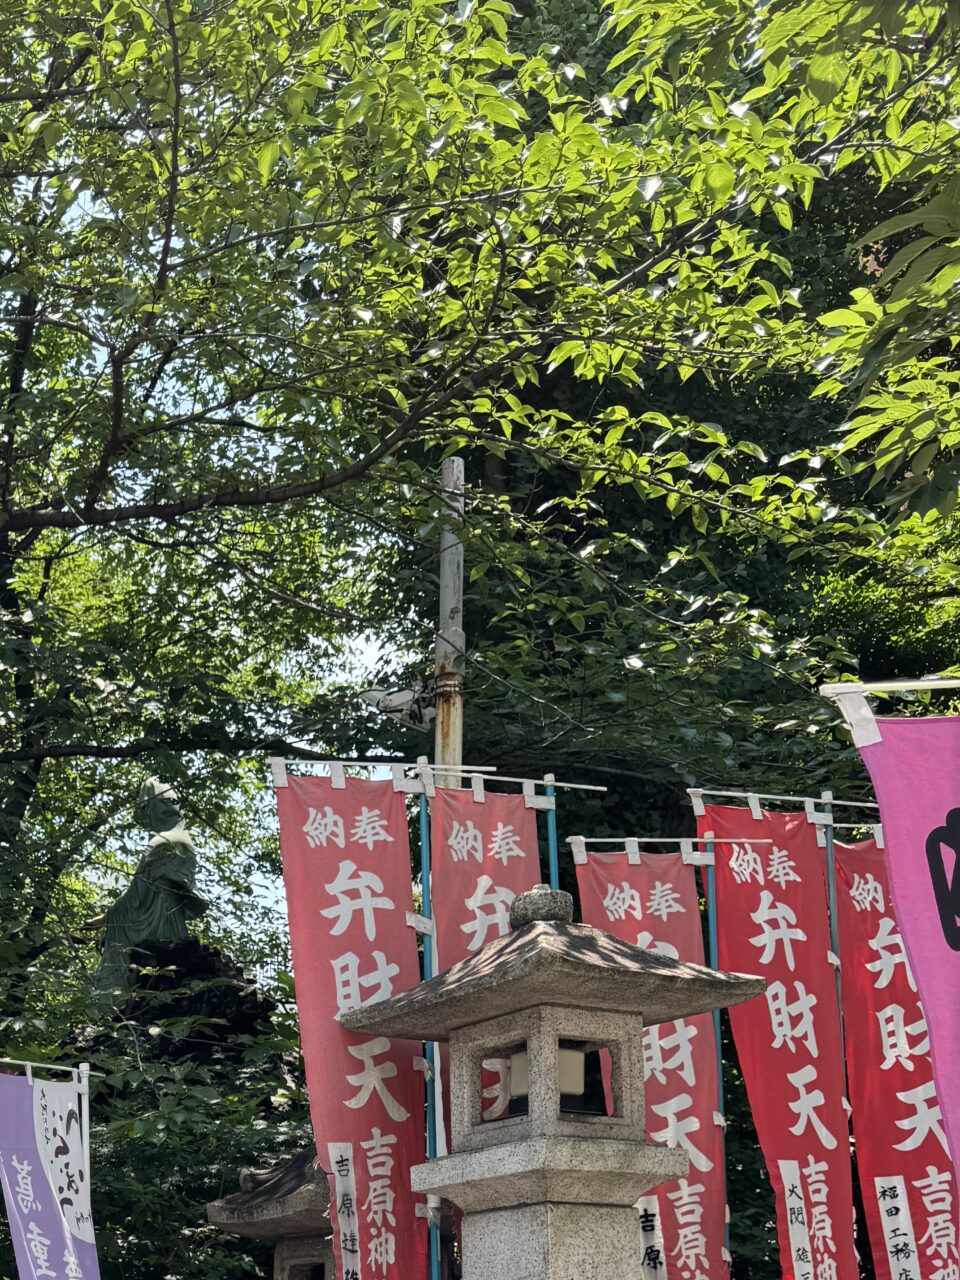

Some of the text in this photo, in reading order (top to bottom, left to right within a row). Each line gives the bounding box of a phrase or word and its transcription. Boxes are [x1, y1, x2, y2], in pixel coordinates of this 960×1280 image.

[320, 860, 410, 1123] 弁財天
[849, 872, 887, 913] 納
[748, 890, 837, 1151] 弁財天
[865, 916, 952, 1162] 弁財天
